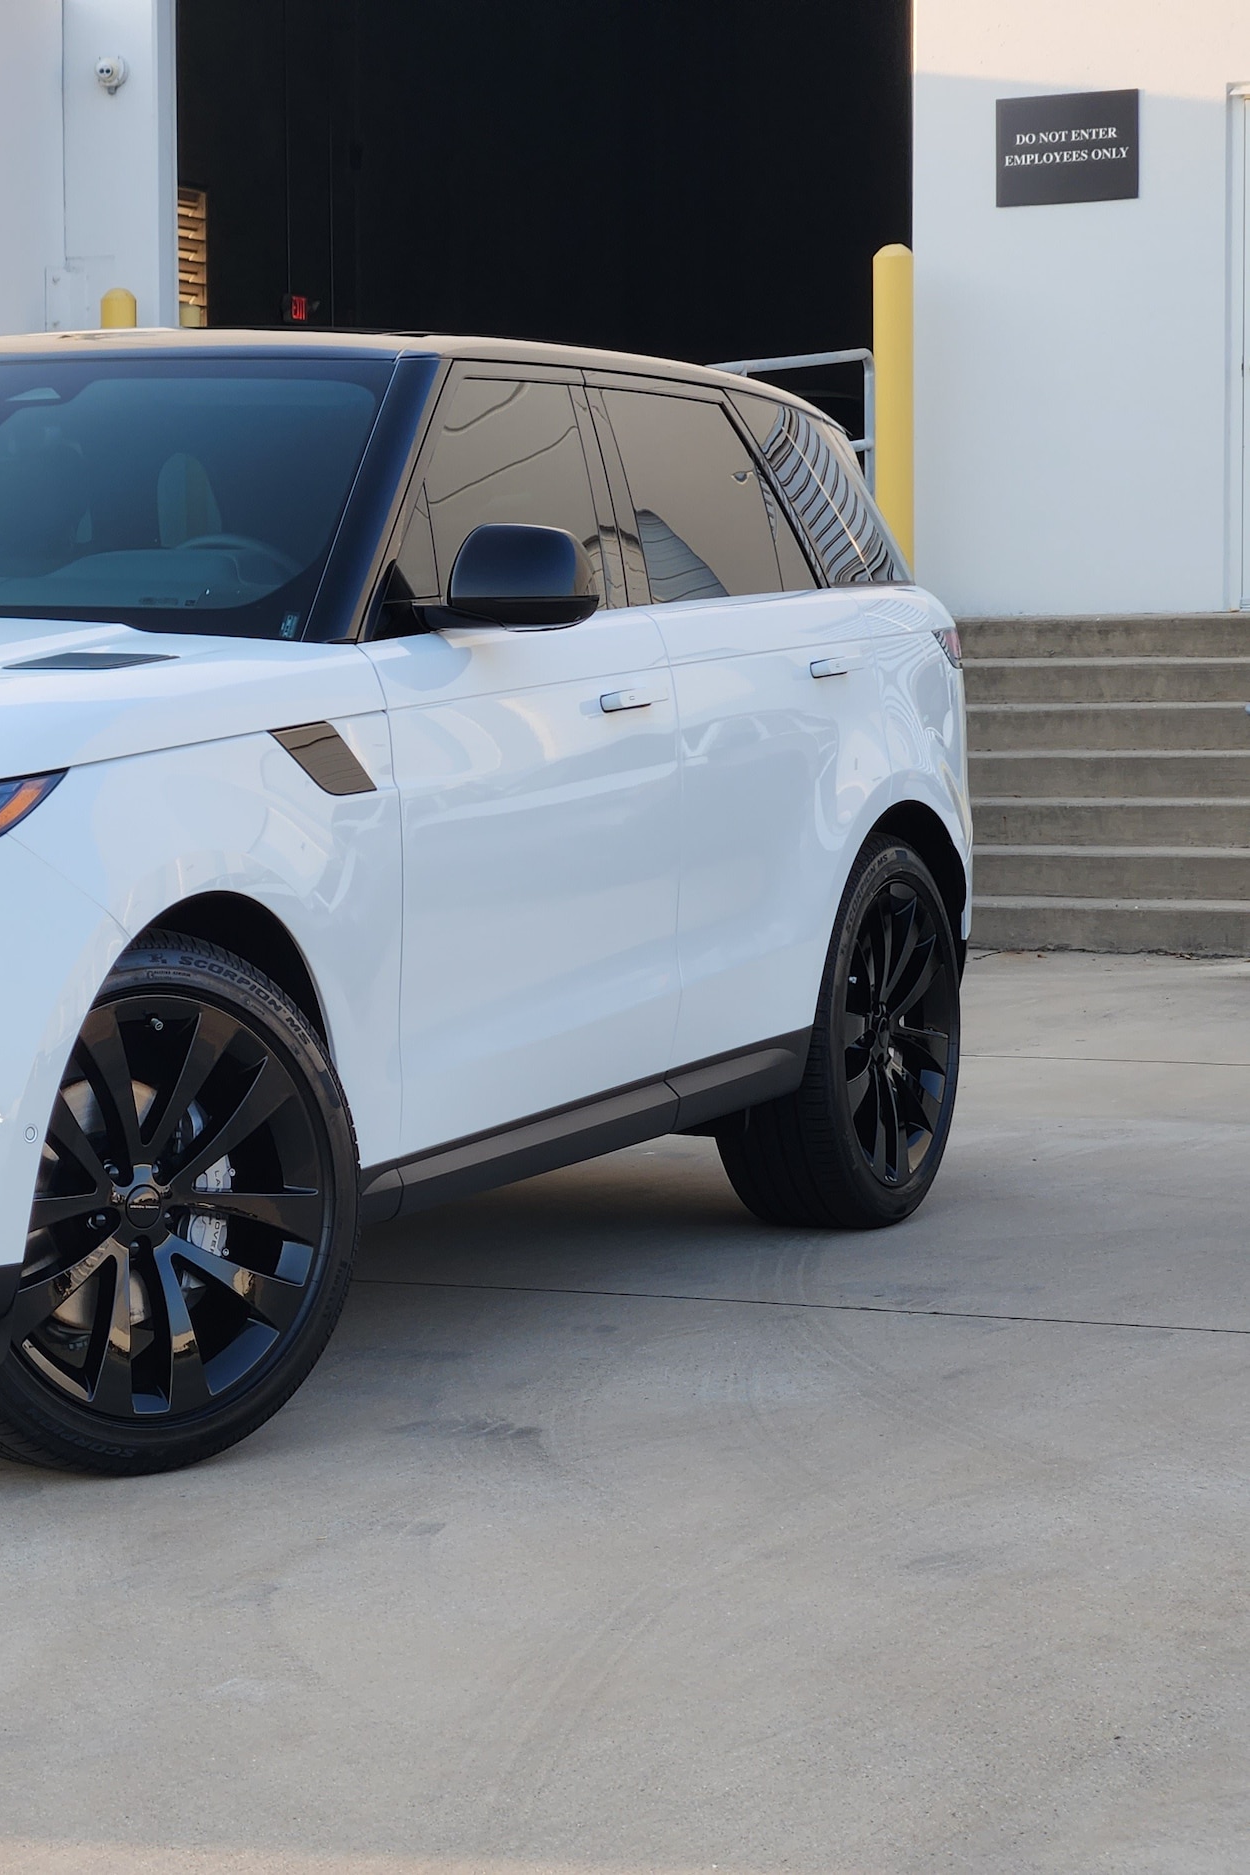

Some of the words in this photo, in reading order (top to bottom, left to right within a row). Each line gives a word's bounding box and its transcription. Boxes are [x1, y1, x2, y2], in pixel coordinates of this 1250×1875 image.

[1015, 133, 1036, 145] DO
[1038, 130, 1068, 144] NOT
[1070, 127, 1117, 142] ENTER
[1004, 149, 1089, 167] EMPLOYEES
[1091, 146, 1129, 161] ONLY
[178, 955, 284, 1013] SCORPION
[285, 1016, 309, 1046] MS
